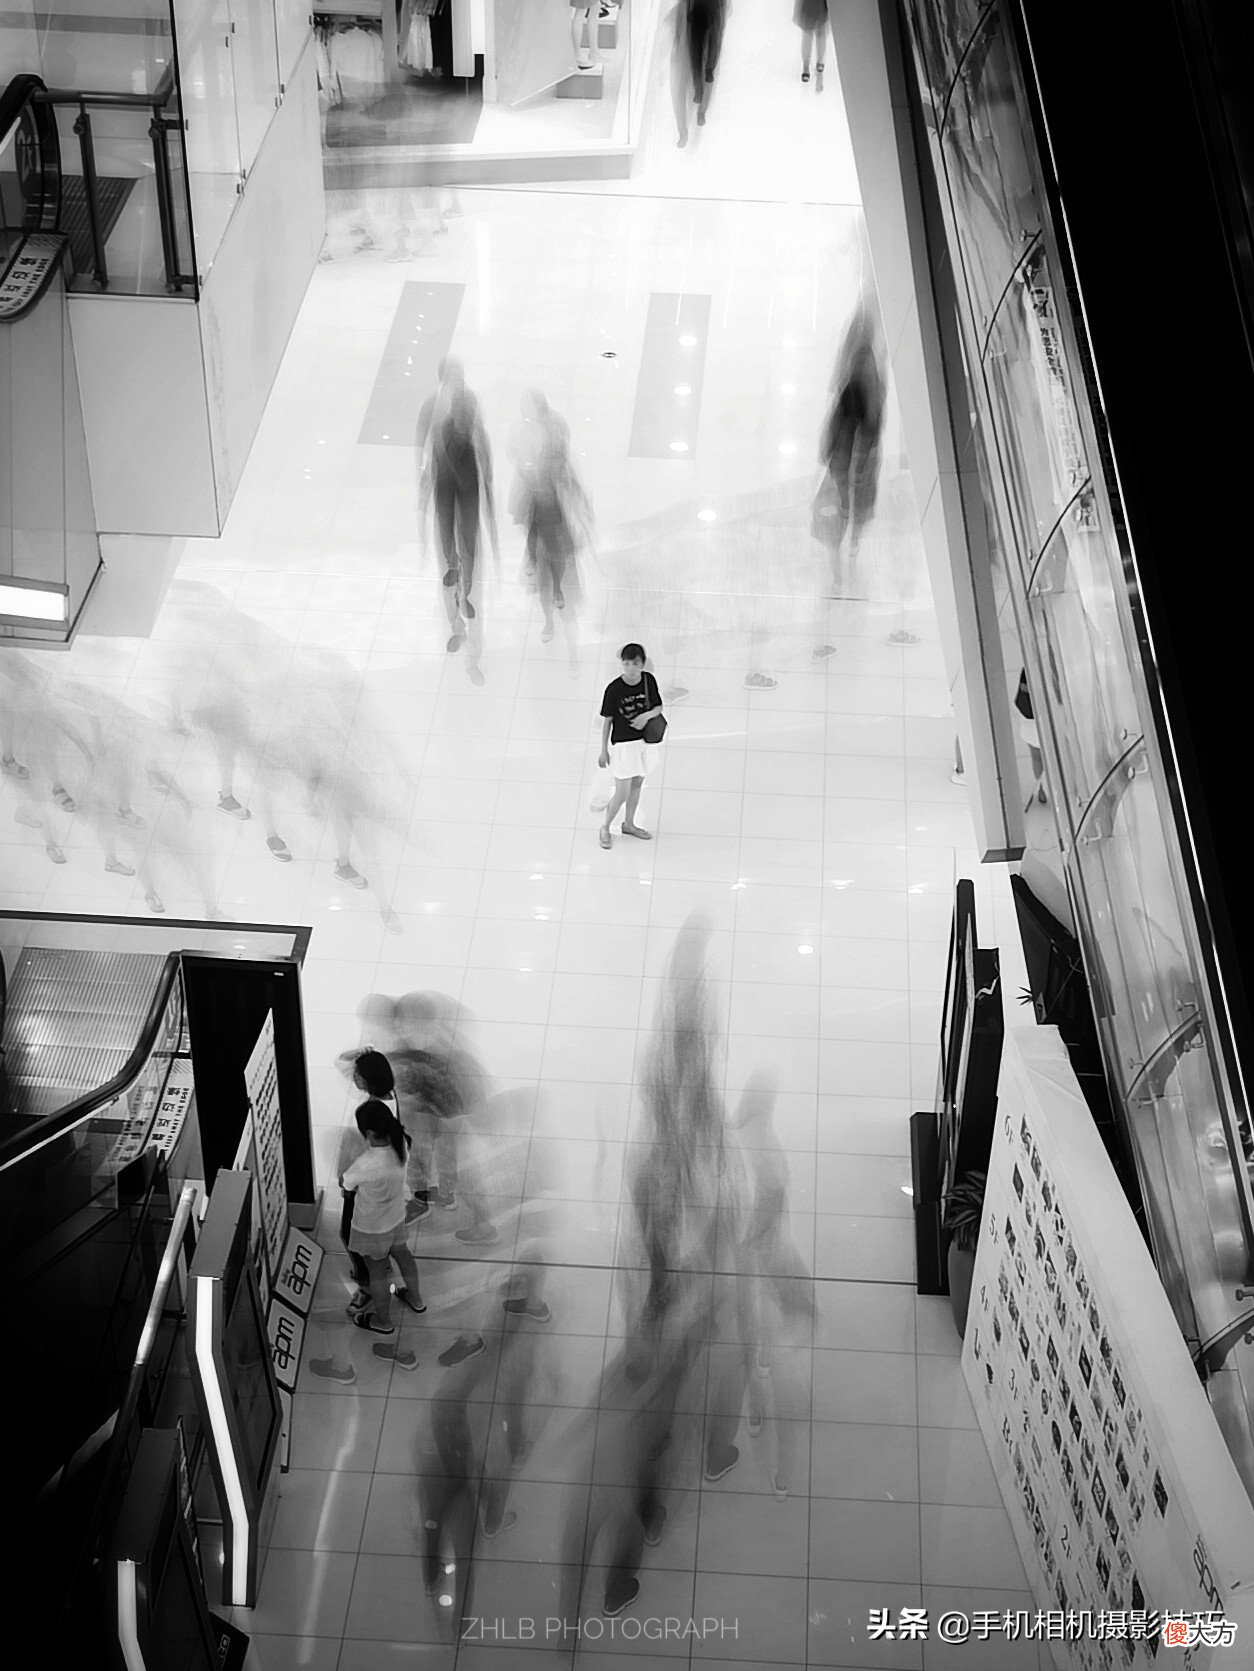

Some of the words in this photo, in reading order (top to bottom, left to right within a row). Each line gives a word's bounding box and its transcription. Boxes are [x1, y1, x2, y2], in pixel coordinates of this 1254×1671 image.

[1004, 1114, 1014, 1144] 6F
[989, 1212, 999, 1244] 5F
[287, 1244, 312, 1296] apm
[273, 1316, 296, 1370] apm
[1008, 1367, 1019, 1401] 3F
[1060, 1524, 1072, 1560] 2F
